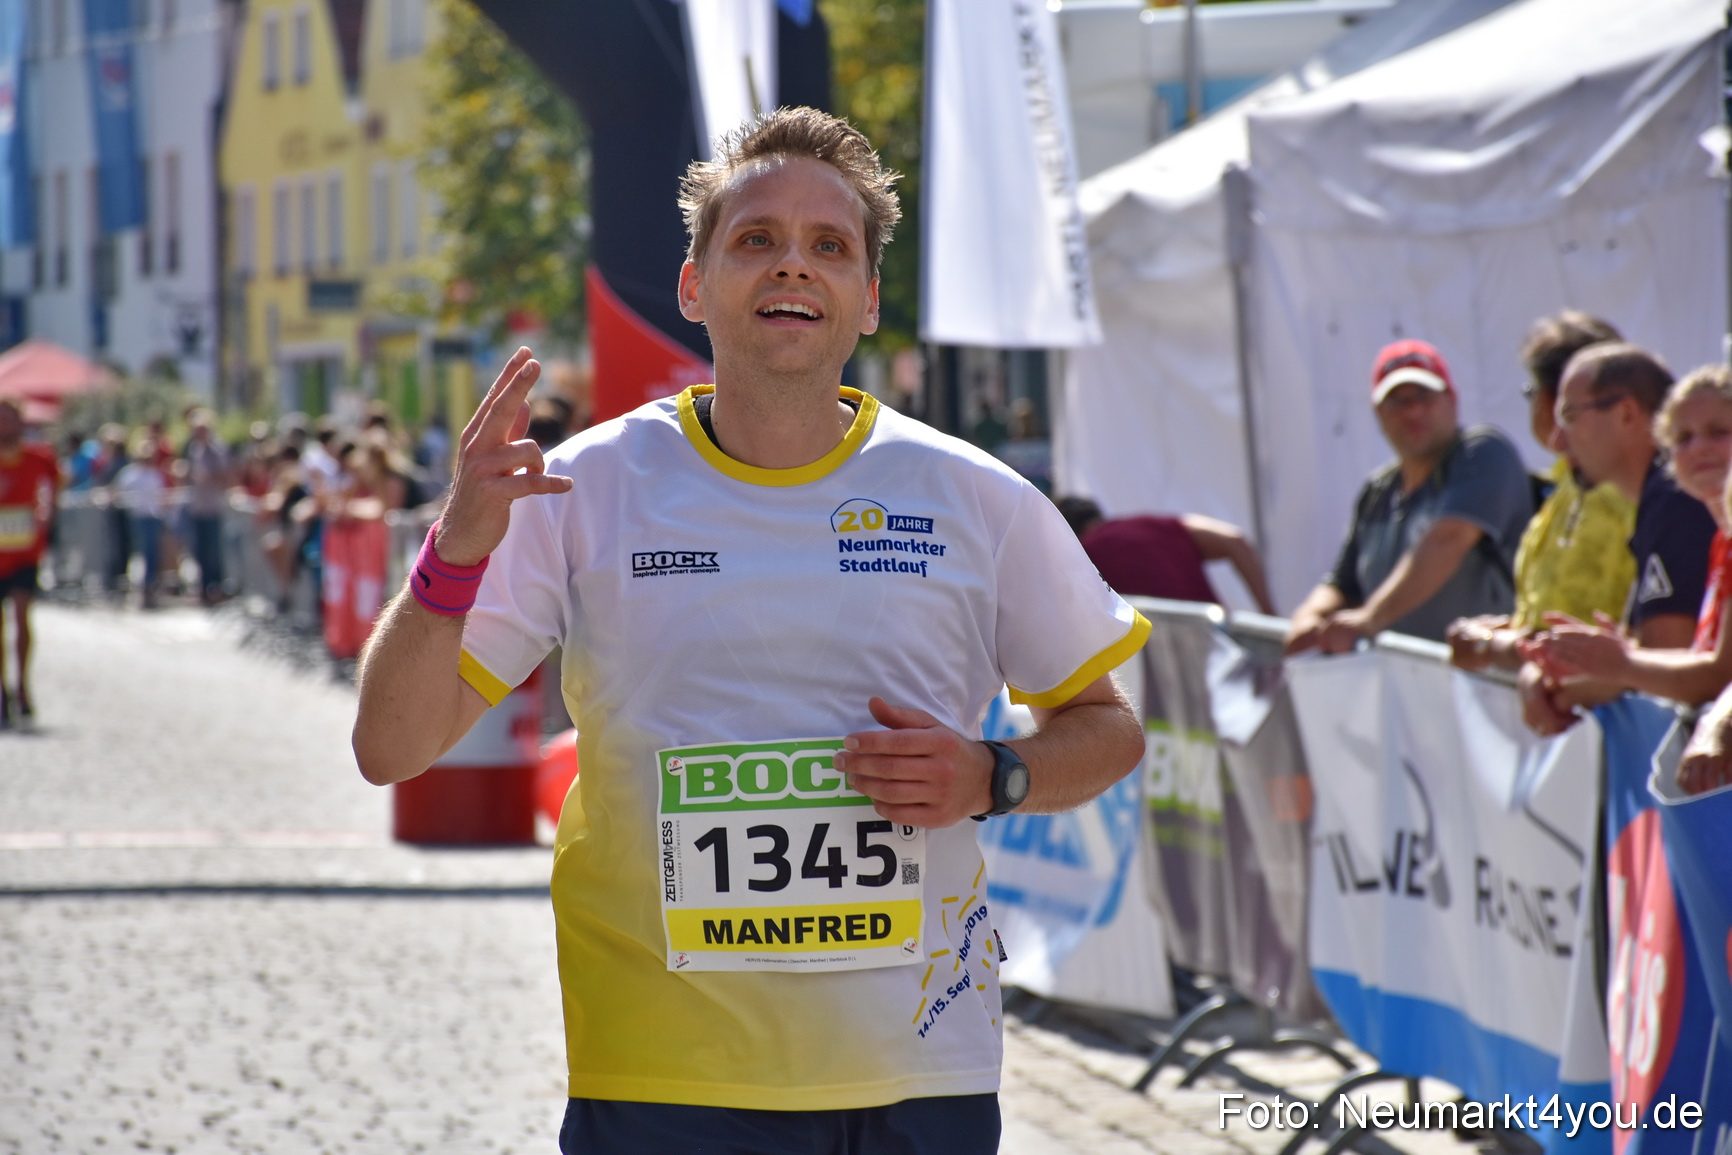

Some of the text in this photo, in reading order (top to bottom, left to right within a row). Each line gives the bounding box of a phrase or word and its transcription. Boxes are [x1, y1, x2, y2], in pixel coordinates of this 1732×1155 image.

[838, 508, 930, 533] 20 JAHRE
[632, 551, 720, 571] BOCK
[838, 538, 947, 556] Neumarkter
[839, 558, 928, 578] Stadtlauf
[680, 750, 856, 804] BOC
[694, 820, 898, 893] 1345
[702, 913, 892, 945] MANFRED
[917, 998, 950, 1039] 14./15.
[964, 905, 988, 937] 2019
